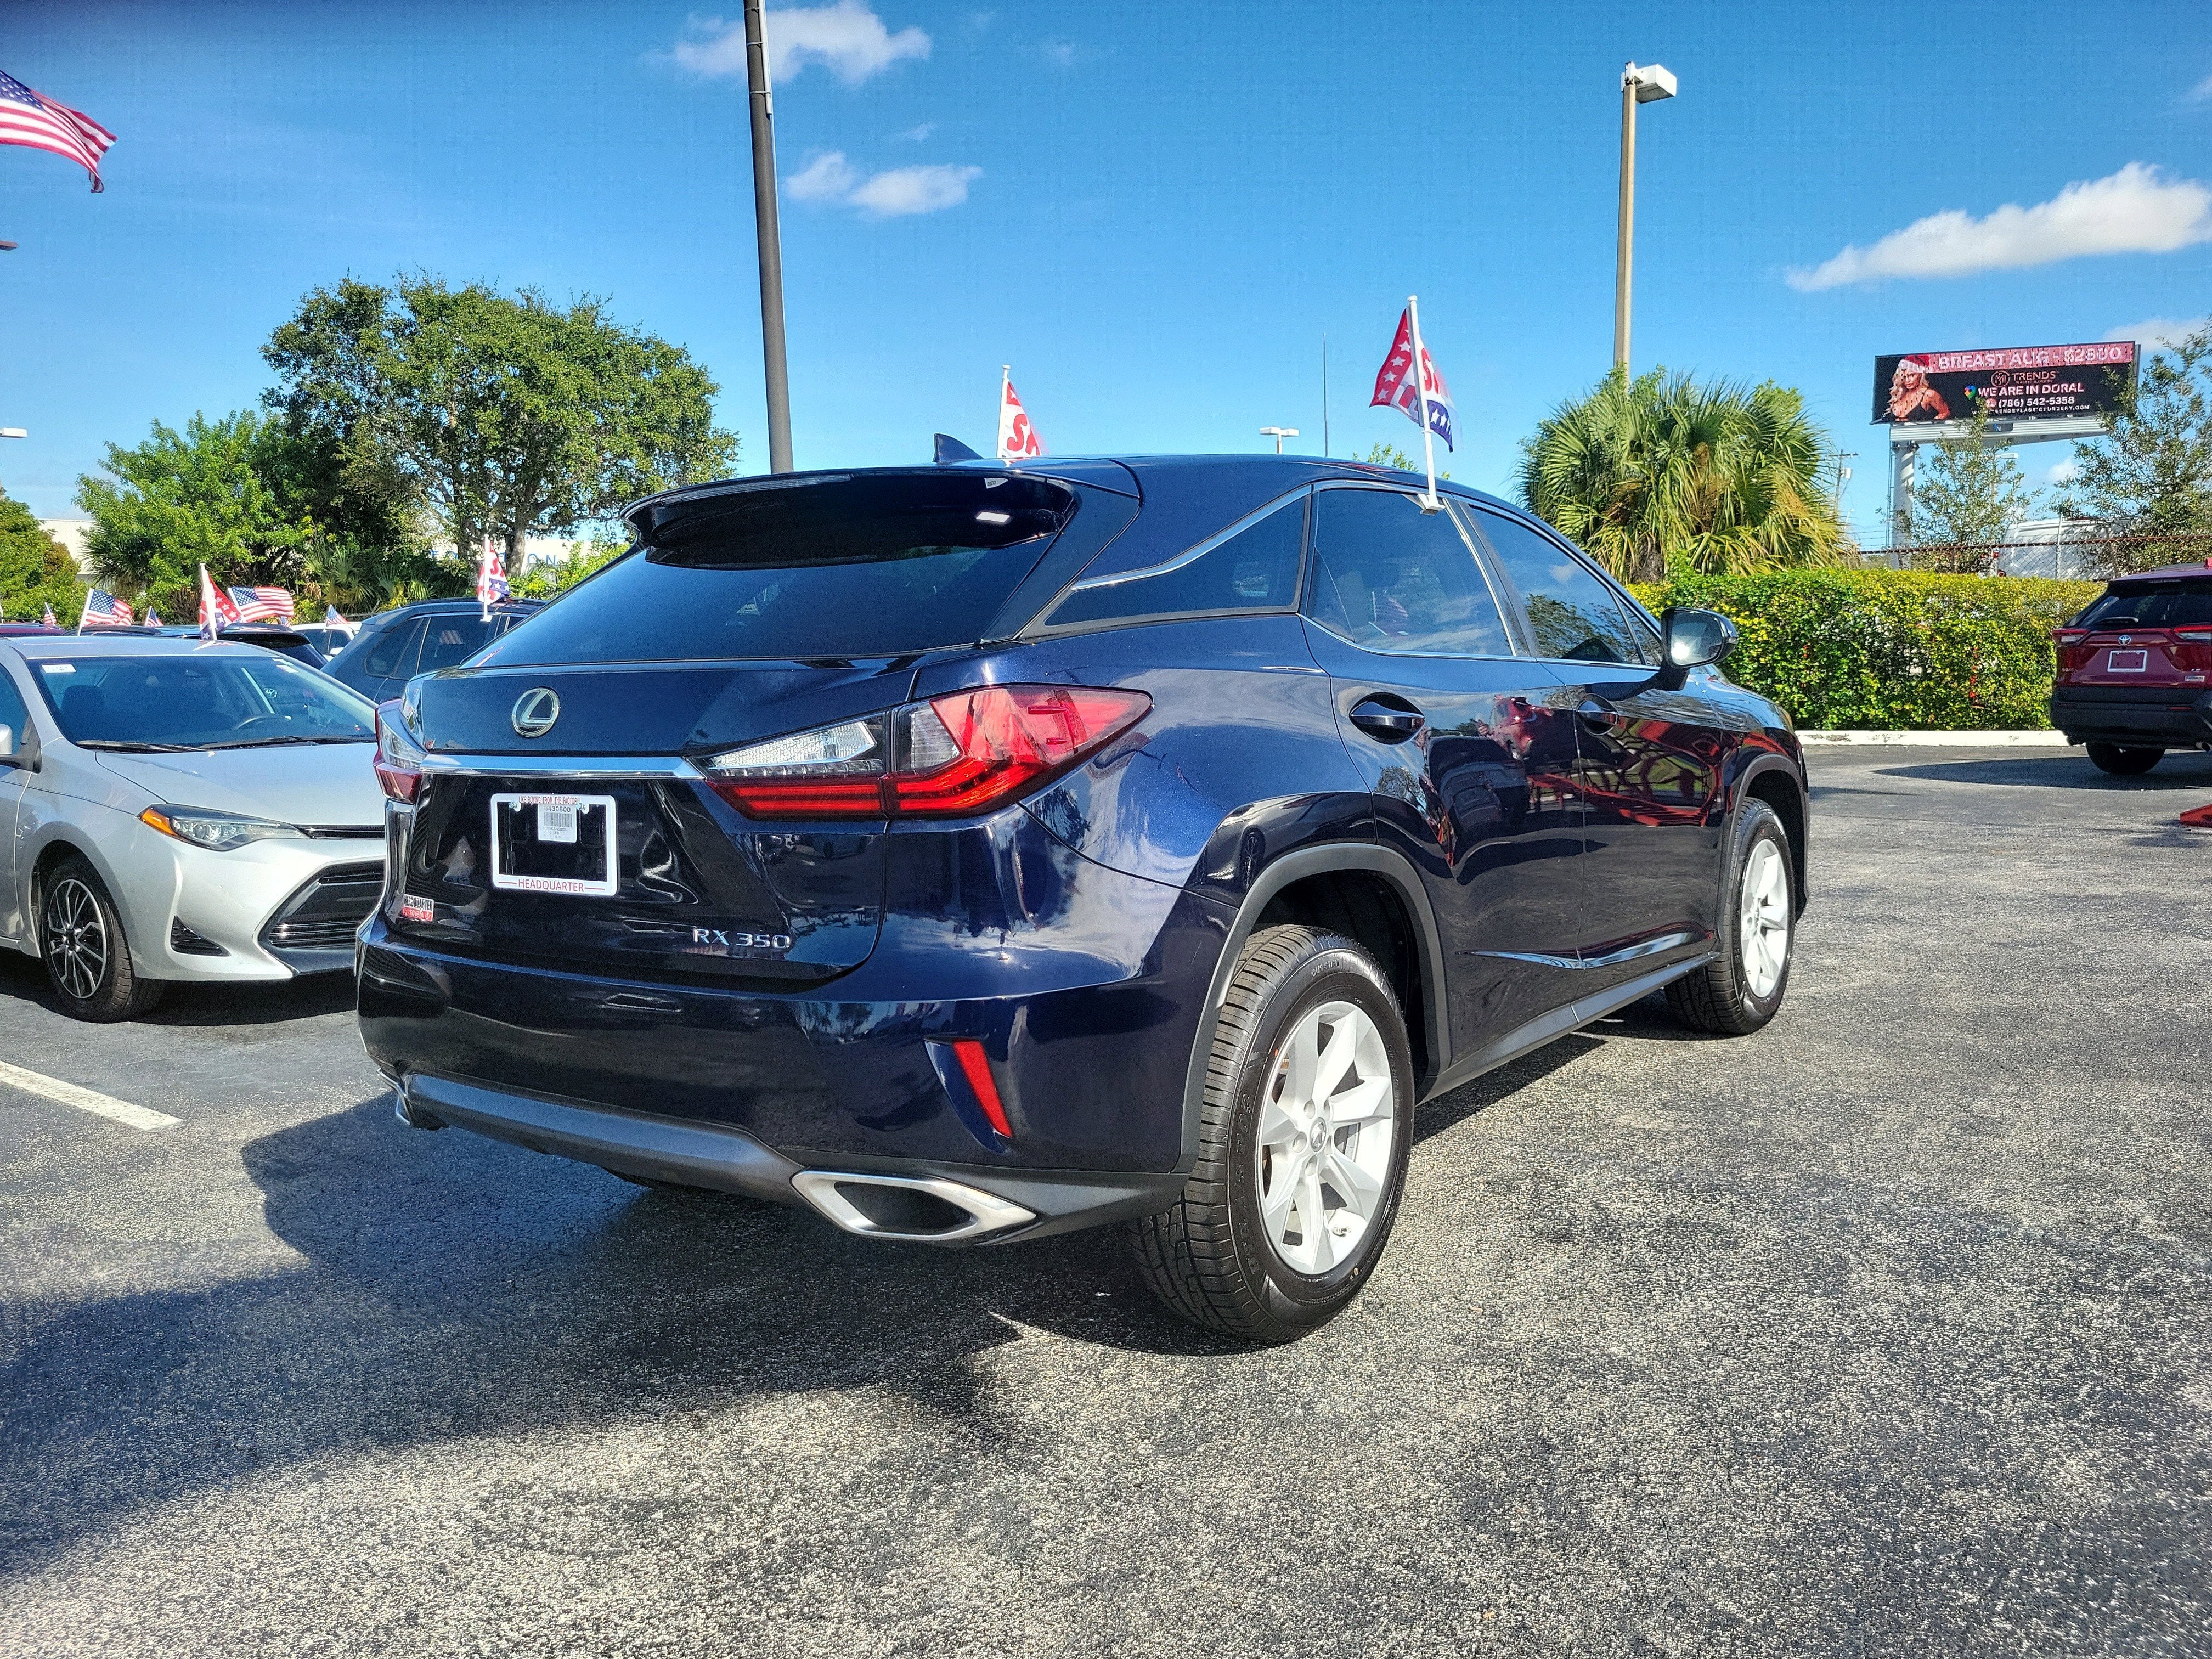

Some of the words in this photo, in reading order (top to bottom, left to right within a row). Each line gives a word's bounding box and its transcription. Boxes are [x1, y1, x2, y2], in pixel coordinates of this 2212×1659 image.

[1938, 353, 2005, 369] BREAST
[2008, 351, 2049, 366] AUG
[2011, 371, 2056, 381] TRENDS
[1978, 387, 1997, 397] WE
[1999, 386, 2024, 396] ARE
[2025, 385, 2039, 395] IN
[2041, 383, 2085, 394] DORAL
[1998, 398, 2024, 409] (786)
[2026, 396, 2075, 407] 542-5358
[543, 796, 553, 805] FROM
[517, 878, 584, 893] HEADQUARTER
[693, 928, 730, 946] RX
[736, 933, 791, 949] 350
